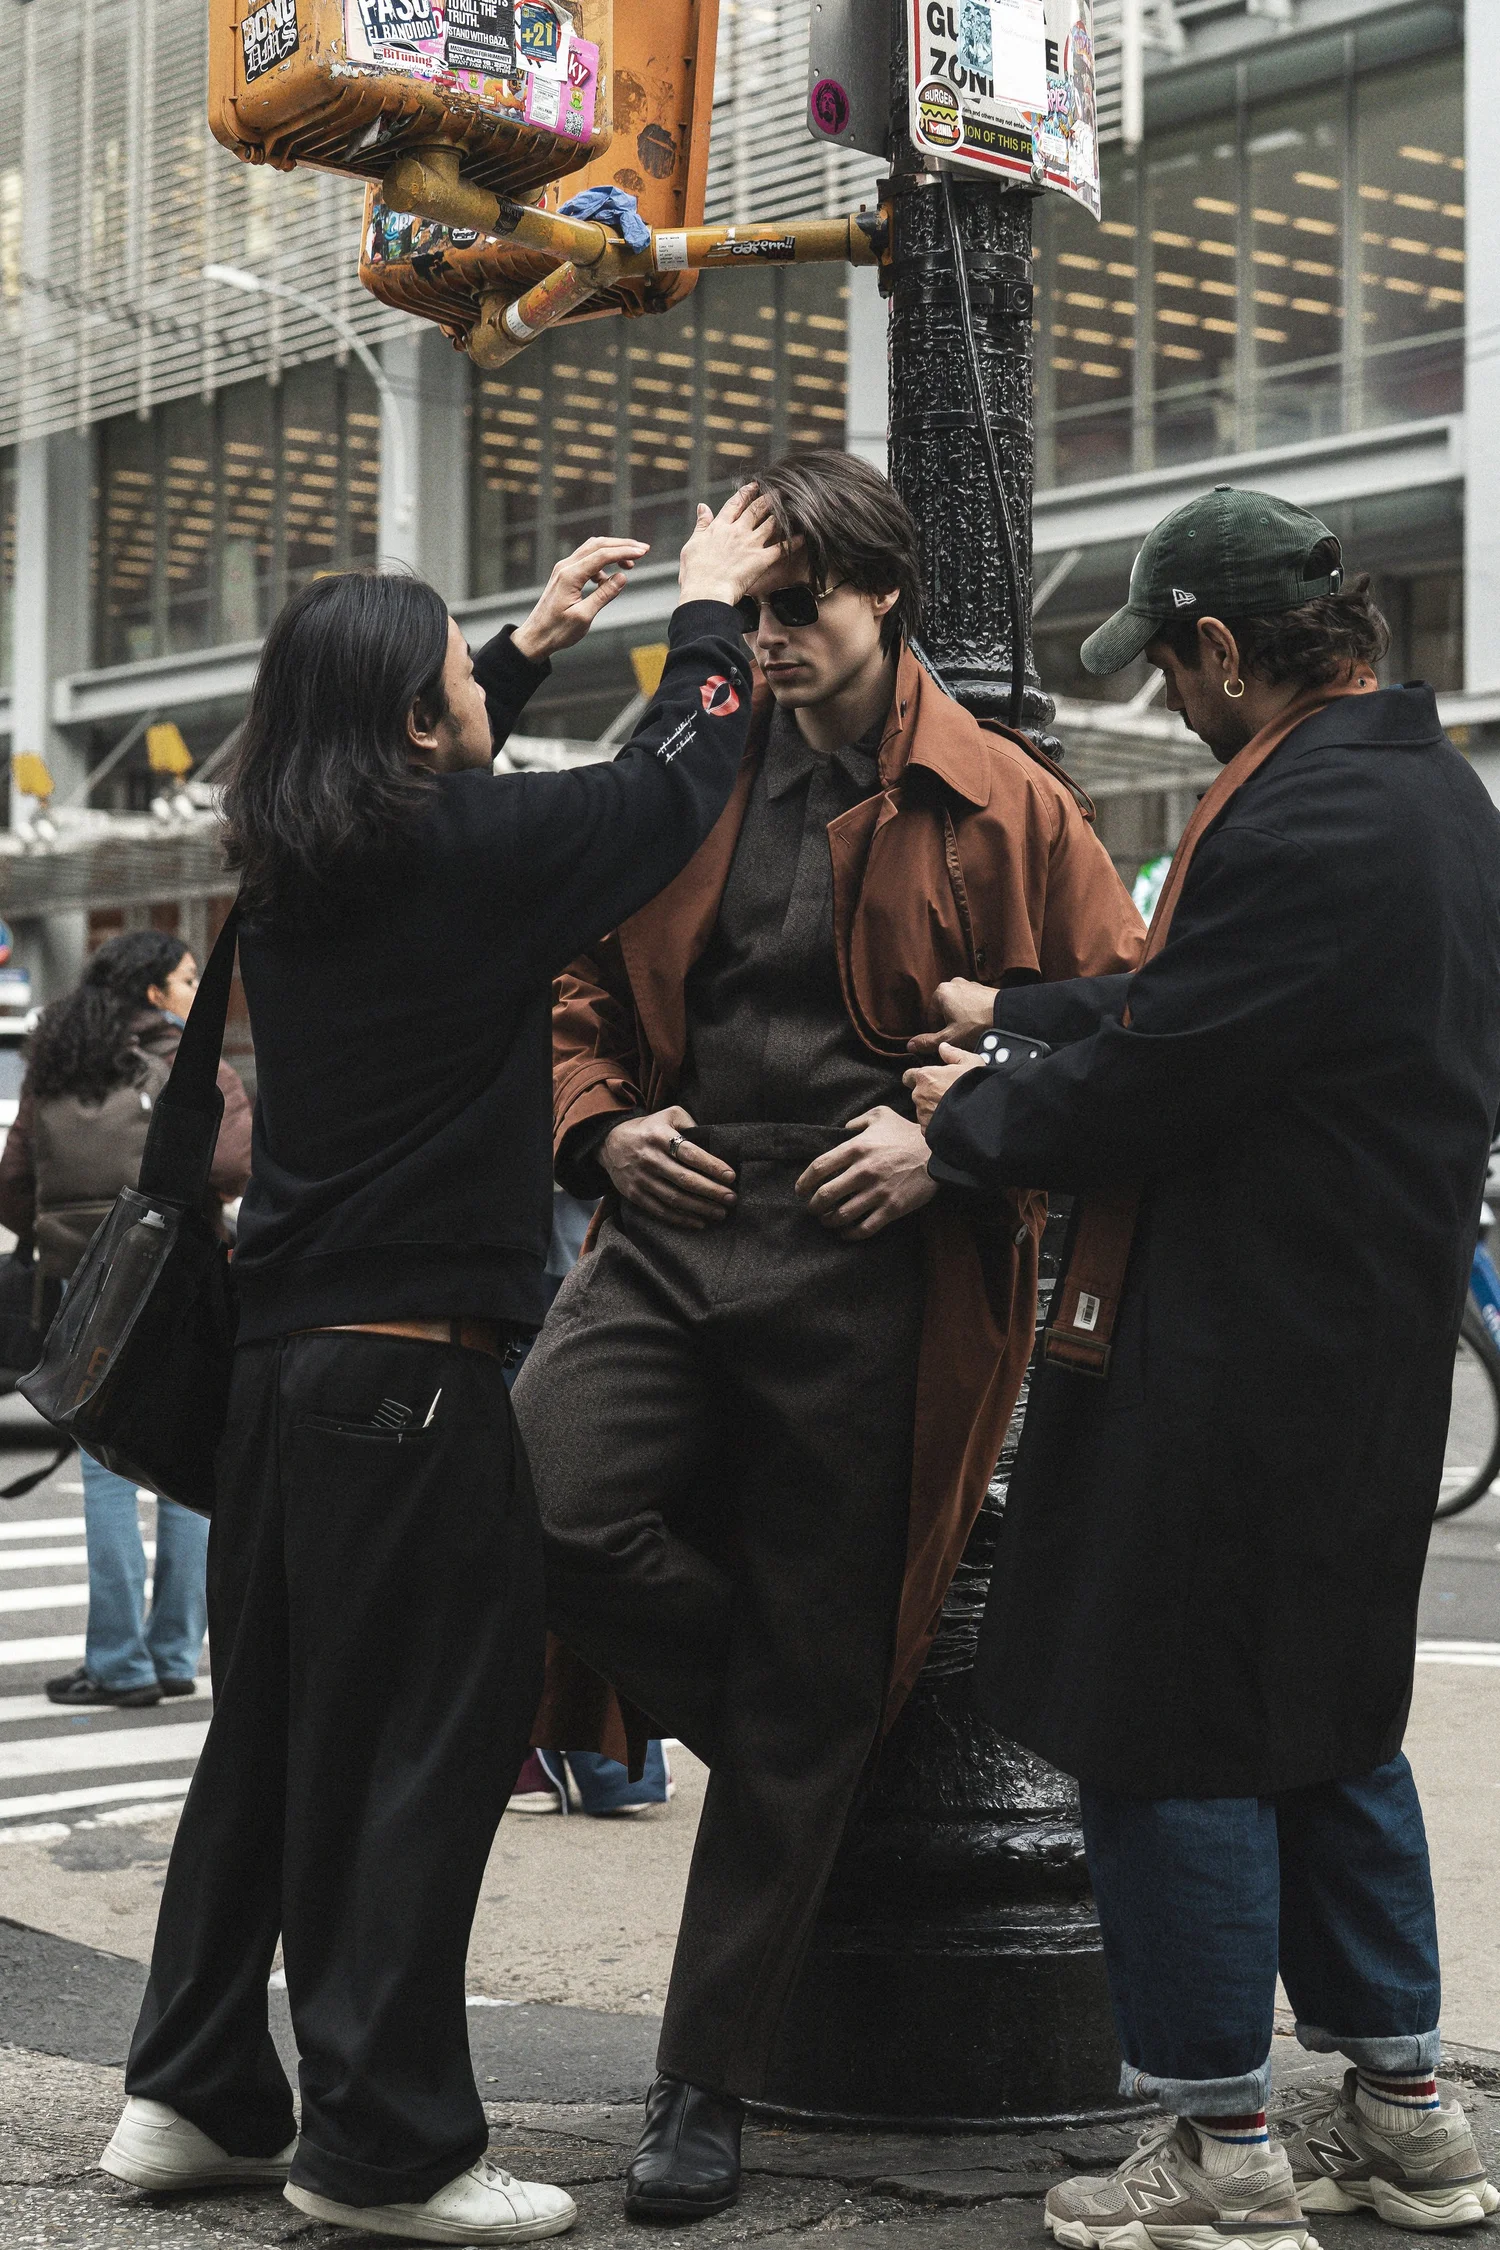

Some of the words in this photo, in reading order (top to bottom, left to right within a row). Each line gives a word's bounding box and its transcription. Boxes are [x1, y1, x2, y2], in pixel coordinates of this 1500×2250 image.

[447, 8, 480, 28] TRUTH.
[460, 0, 480, 15] KILL
[480, 2, 498, 18] THE
[242, 0, 295, 51] BONG
[382, 20, 436, 40] BANDIDO!
[448, 26, 470, 39] STAND
[470, 30, 489, 44] WITH
[489, 34, 510, 47] GAZA.
[383, 48, 433, 68] BiTuning
[930, 47, 995, 99] ZON
[924, 89, 954, 105] BURGER
[972, 109, 981, 117] and
[981, 112, 995, 121] others
[995, 116, 1005, 125] may
[1013, 122, 1026, 130] enter
[963, 124, 981, 140] ION
[983, 130, 996, 144] OF
[997, 134, 1018, 151] THIS
[1020, 140, 1033, 154] PR
